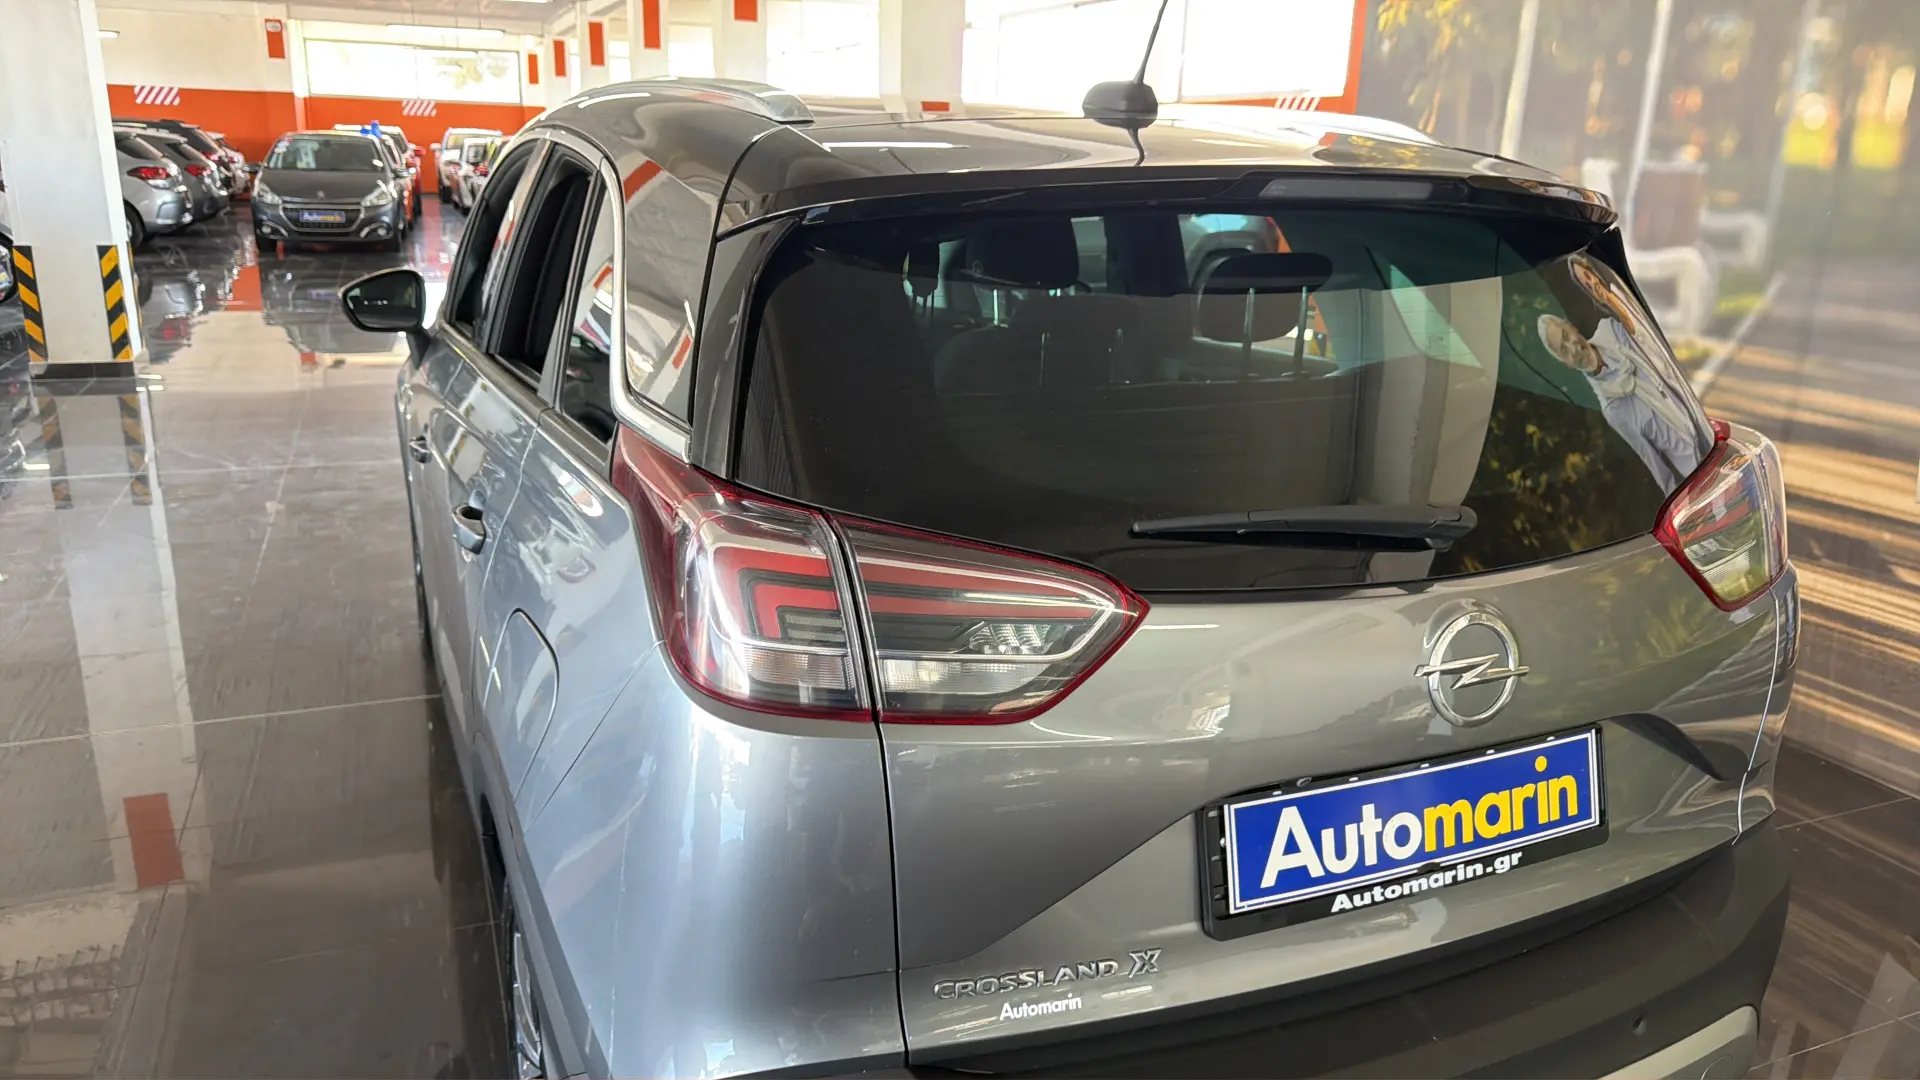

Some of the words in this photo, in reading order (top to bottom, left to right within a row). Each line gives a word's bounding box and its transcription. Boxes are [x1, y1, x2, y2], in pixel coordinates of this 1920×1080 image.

[303, 212, 342, 221] Autom
[1259, 755, 1578, 889] Automarin
[1330, 849, 1523, 913] Automarin.gr
[934, 958, 1119, 1000] CROSSLAND
[1128, 948, 1162, 978] X
[1000, 993, 1083, 1020] Automarin
